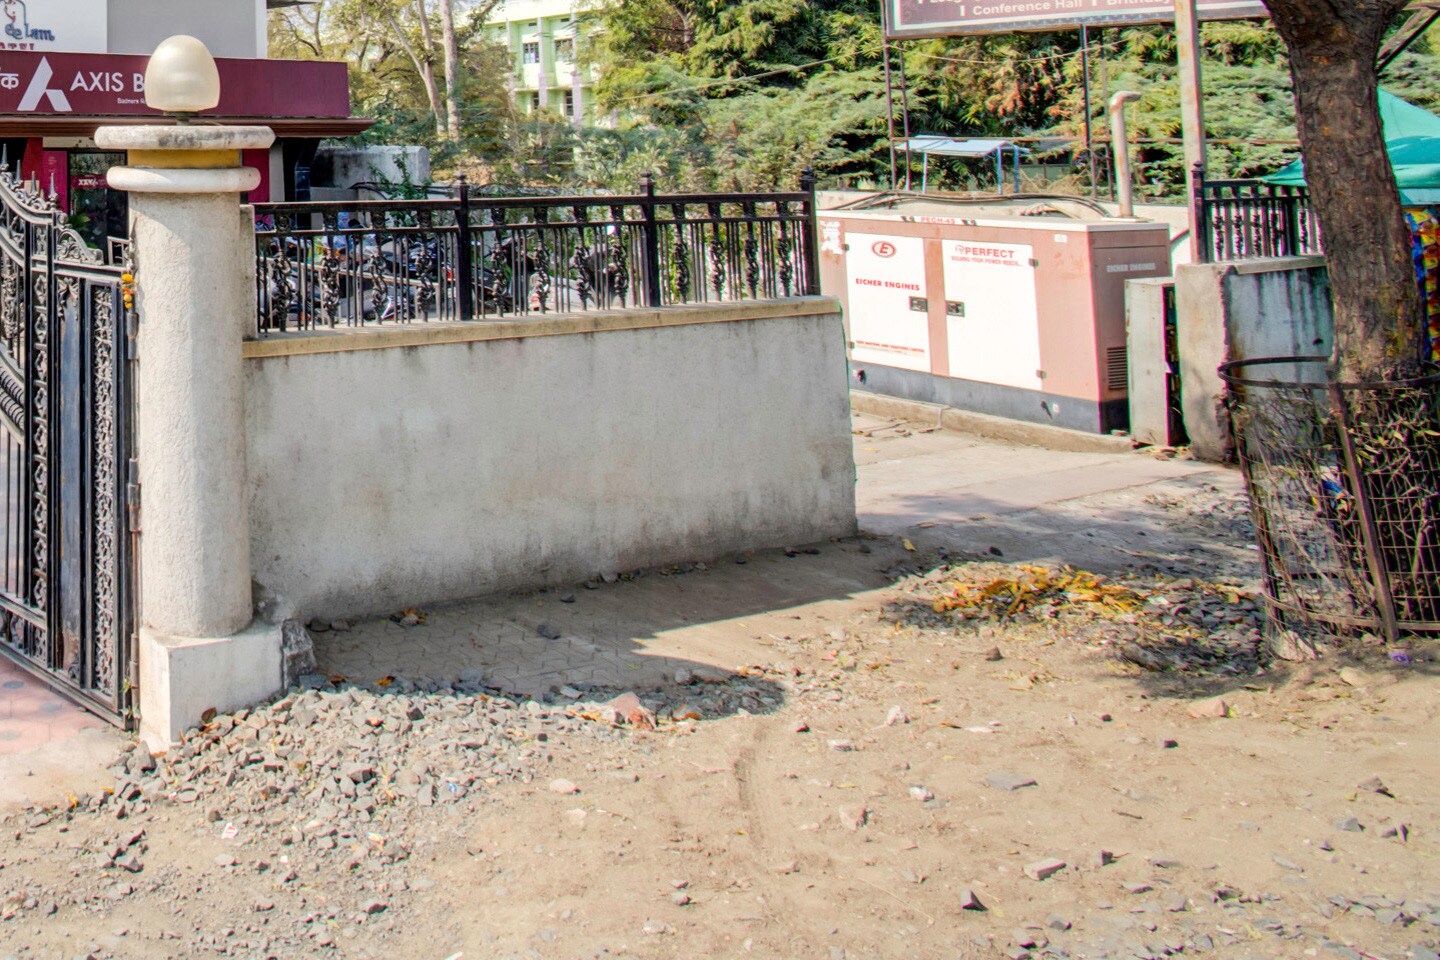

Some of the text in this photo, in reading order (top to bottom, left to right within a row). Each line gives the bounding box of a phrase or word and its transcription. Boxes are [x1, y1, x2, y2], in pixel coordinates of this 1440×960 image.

[972, 1, 1052, 16] Conference
[70, 71, 125, 93] AXIS
[964, 247, 1015, 258] PERFECT
[855, 278, 920, 291] EICHER ENGINES
